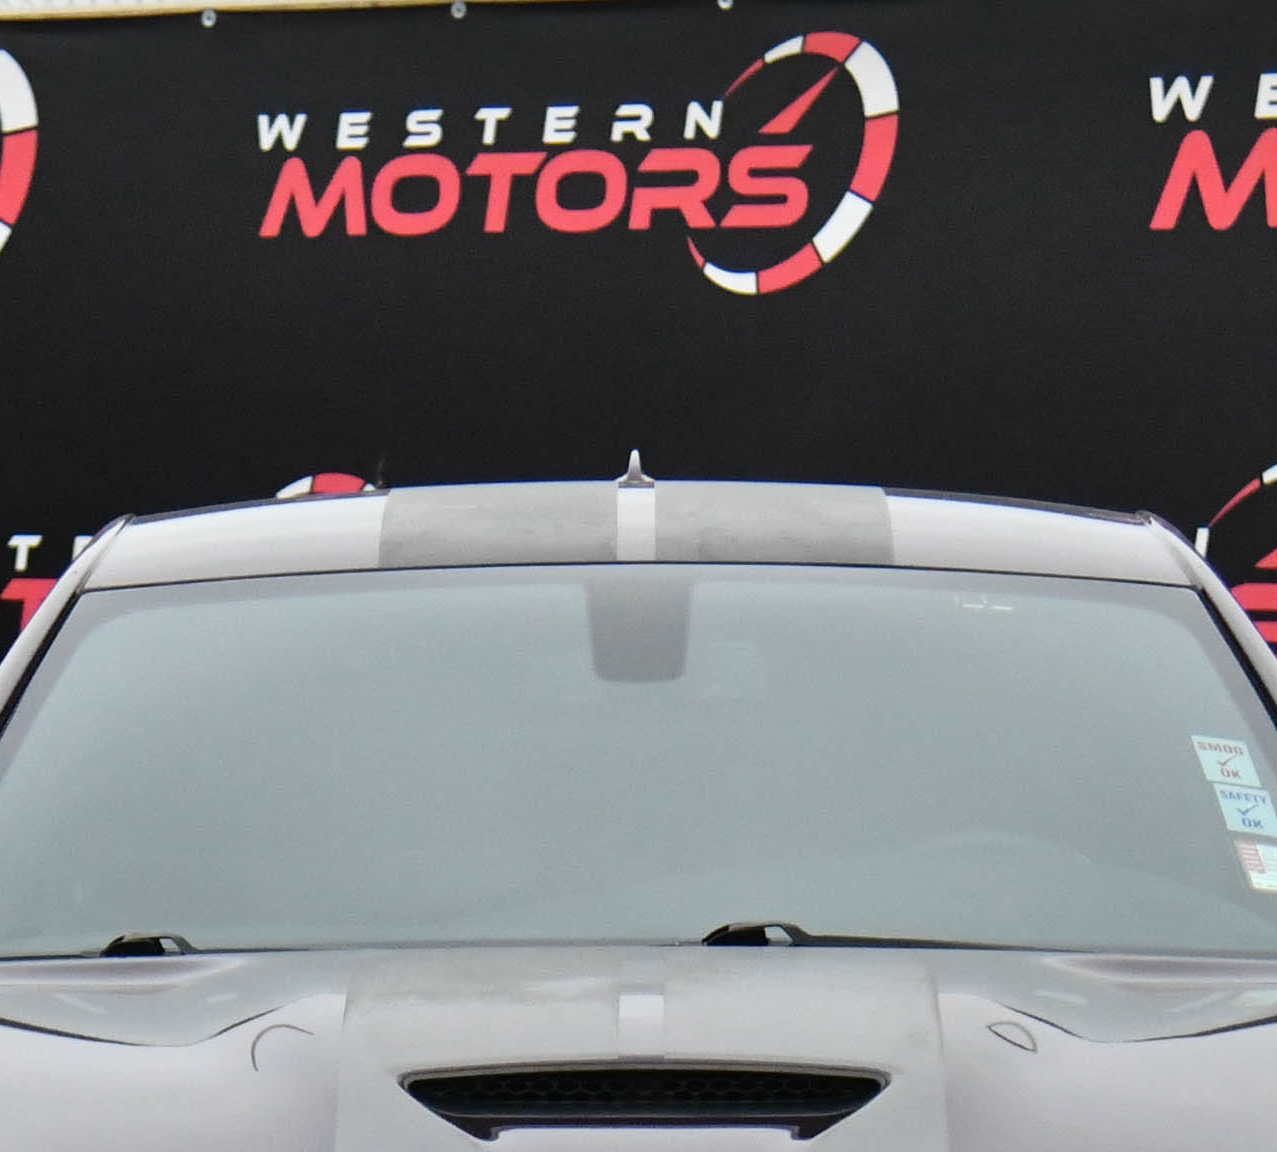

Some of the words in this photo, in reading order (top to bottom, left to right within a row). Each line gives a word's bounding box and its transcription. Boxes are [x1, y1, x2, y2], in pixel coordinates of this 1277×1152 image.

[257, 100, 724, 151] WESTERN
[259, 145, 814, 238] MOTORS
[1219, 767, 1242, 780] OK
[1218, 788, 1267, 805] SAFETY
[1240, 817, 1265, 830] OK
